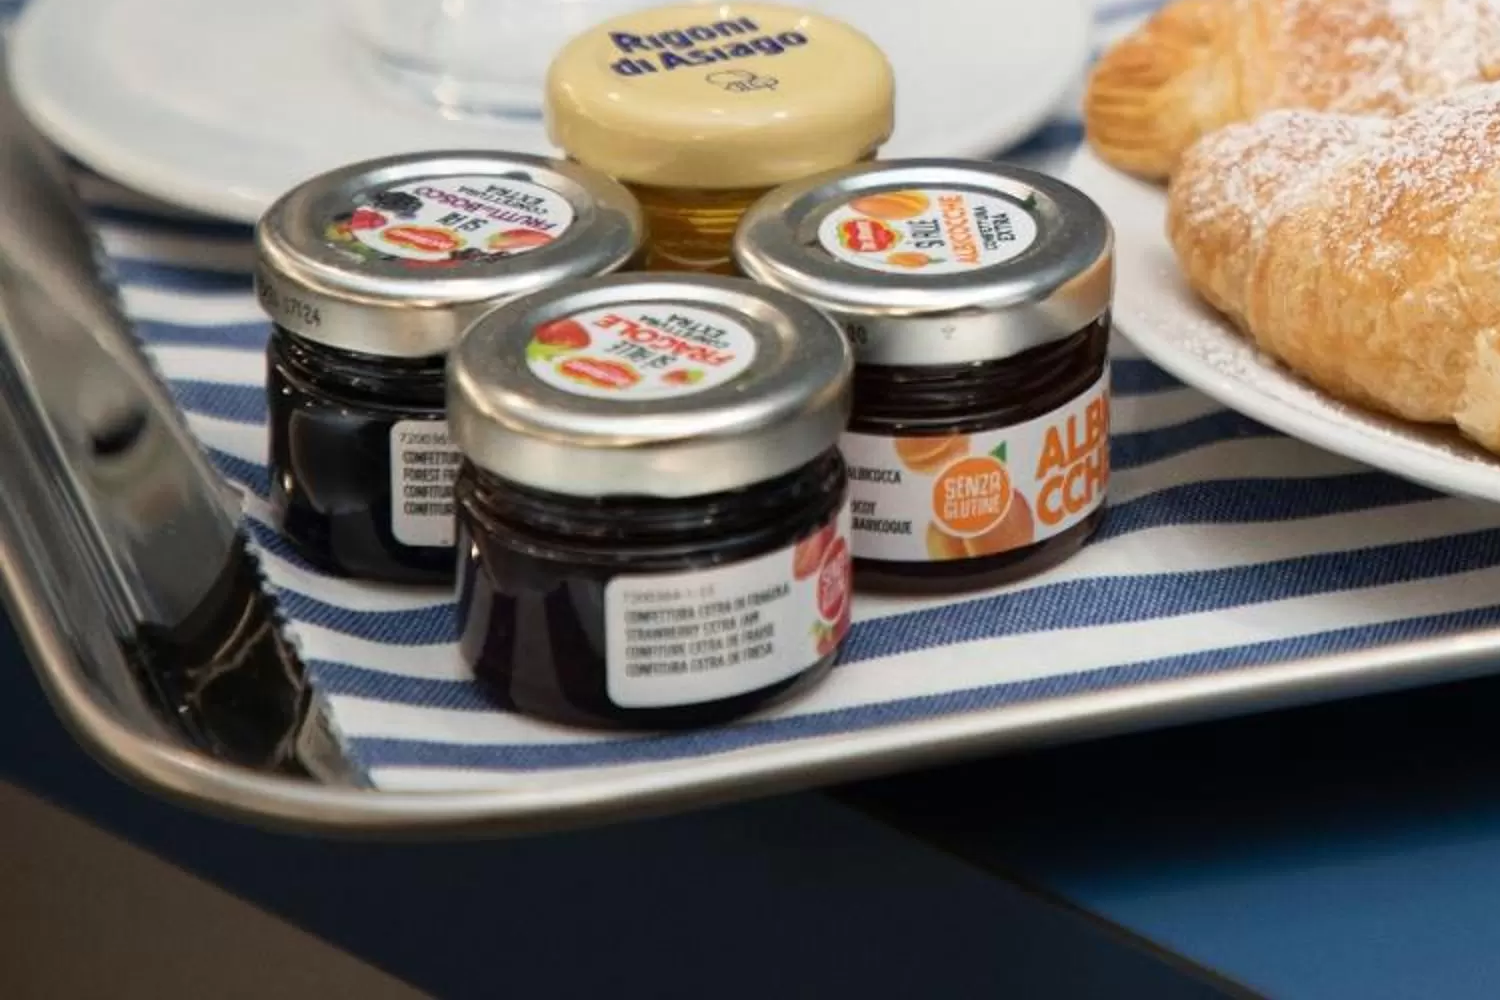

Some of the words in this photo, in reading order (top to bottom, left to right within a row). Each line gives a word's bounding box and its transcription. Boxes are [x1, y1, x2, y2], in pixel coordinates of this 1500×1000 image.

[608, 17, 759, 52] Rigoni
[610, 57, 658, 77] di
[657, 31, 808, 71] Asiago
[414, 186, 482, 212] BOSCO
[489, 207, 557, 230] FRUTTI
[938, 195, 981, 263] ALBICOCCHE
[992, 212, 1016, 241] EXTRA
[593, 313, 737, 365] FRAGOLE
[944, 472, 1000, 498] SENZA
[944, 495, 1000, 520] GLUTINE
